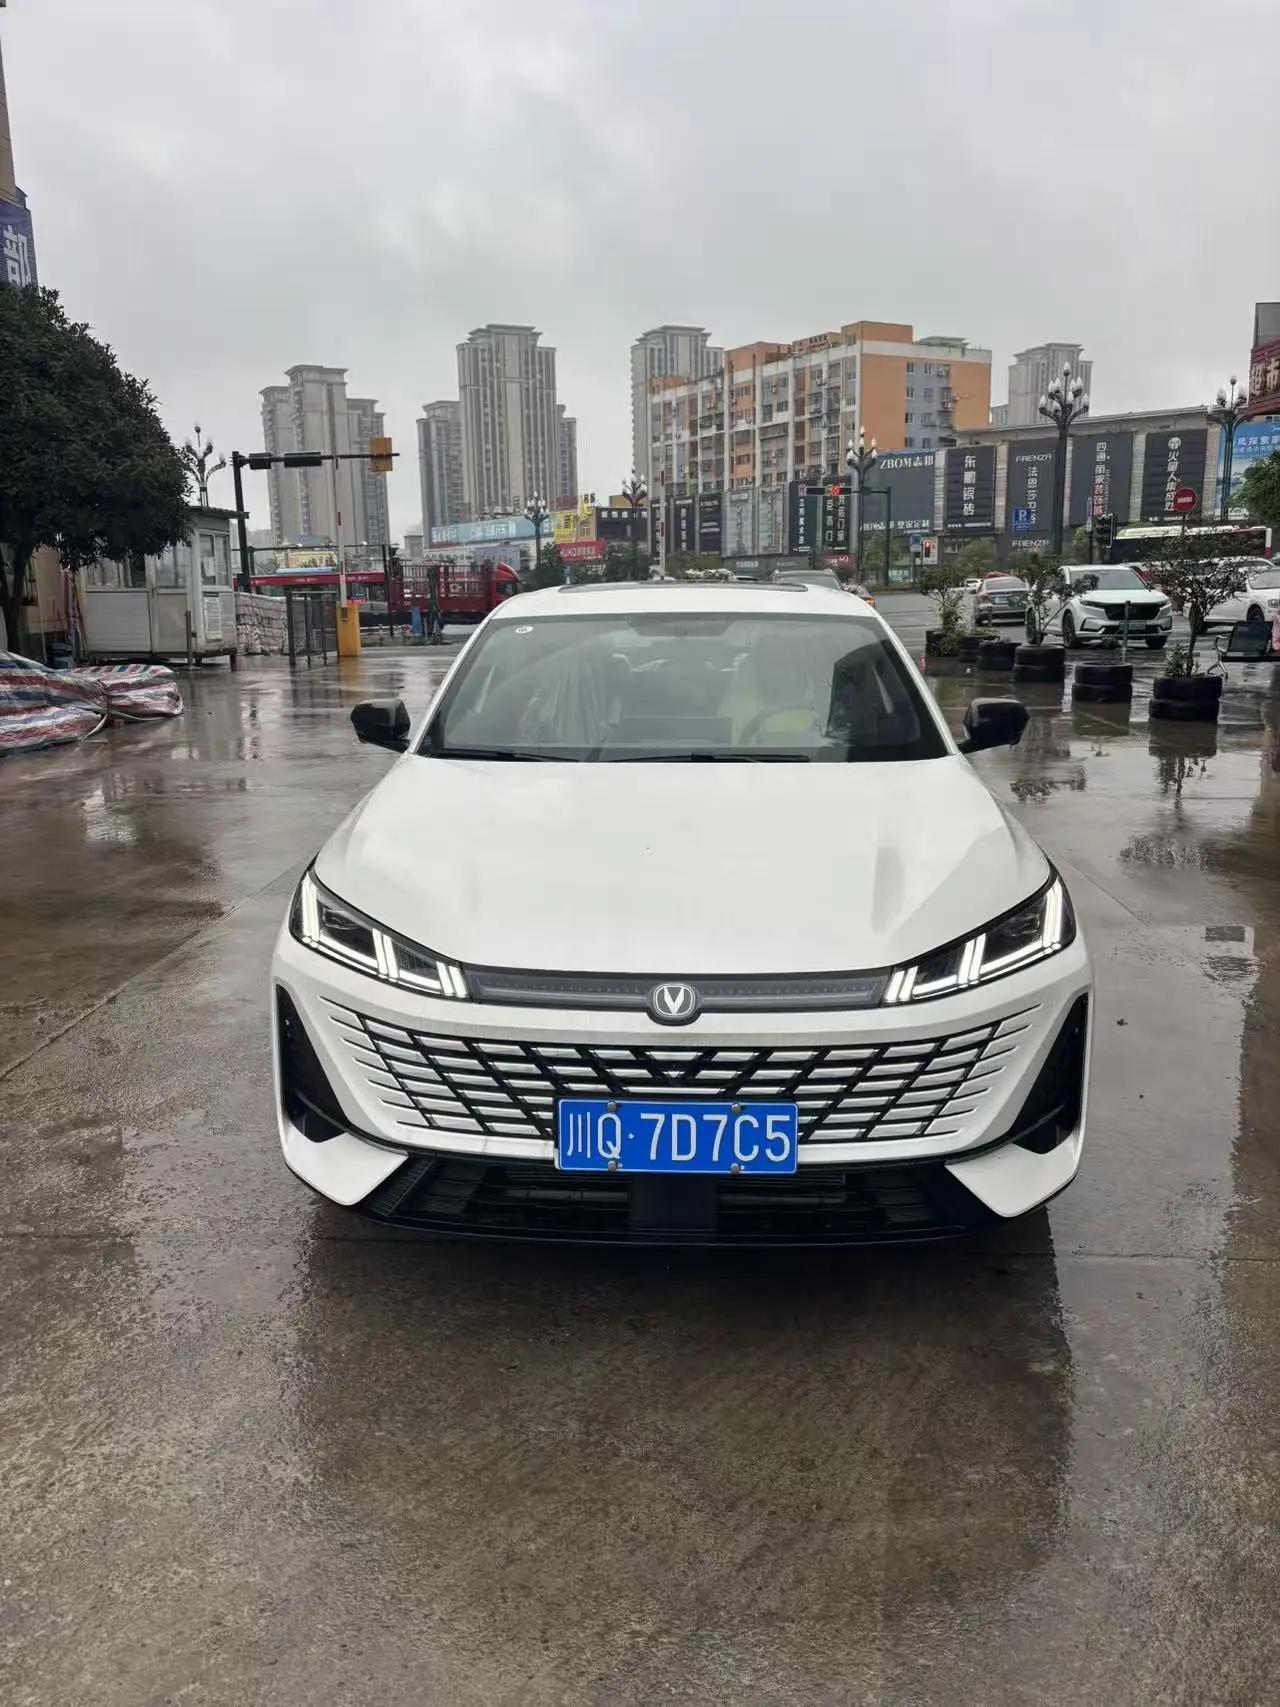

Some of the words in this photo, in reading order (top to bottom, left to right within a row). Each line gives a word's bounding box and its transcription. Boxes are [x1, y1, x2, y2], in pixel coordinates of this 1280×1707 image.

[1015, 453, 1052, 463] FAENZA
[963, 455, 976, 516] 东鹏瓷砖
